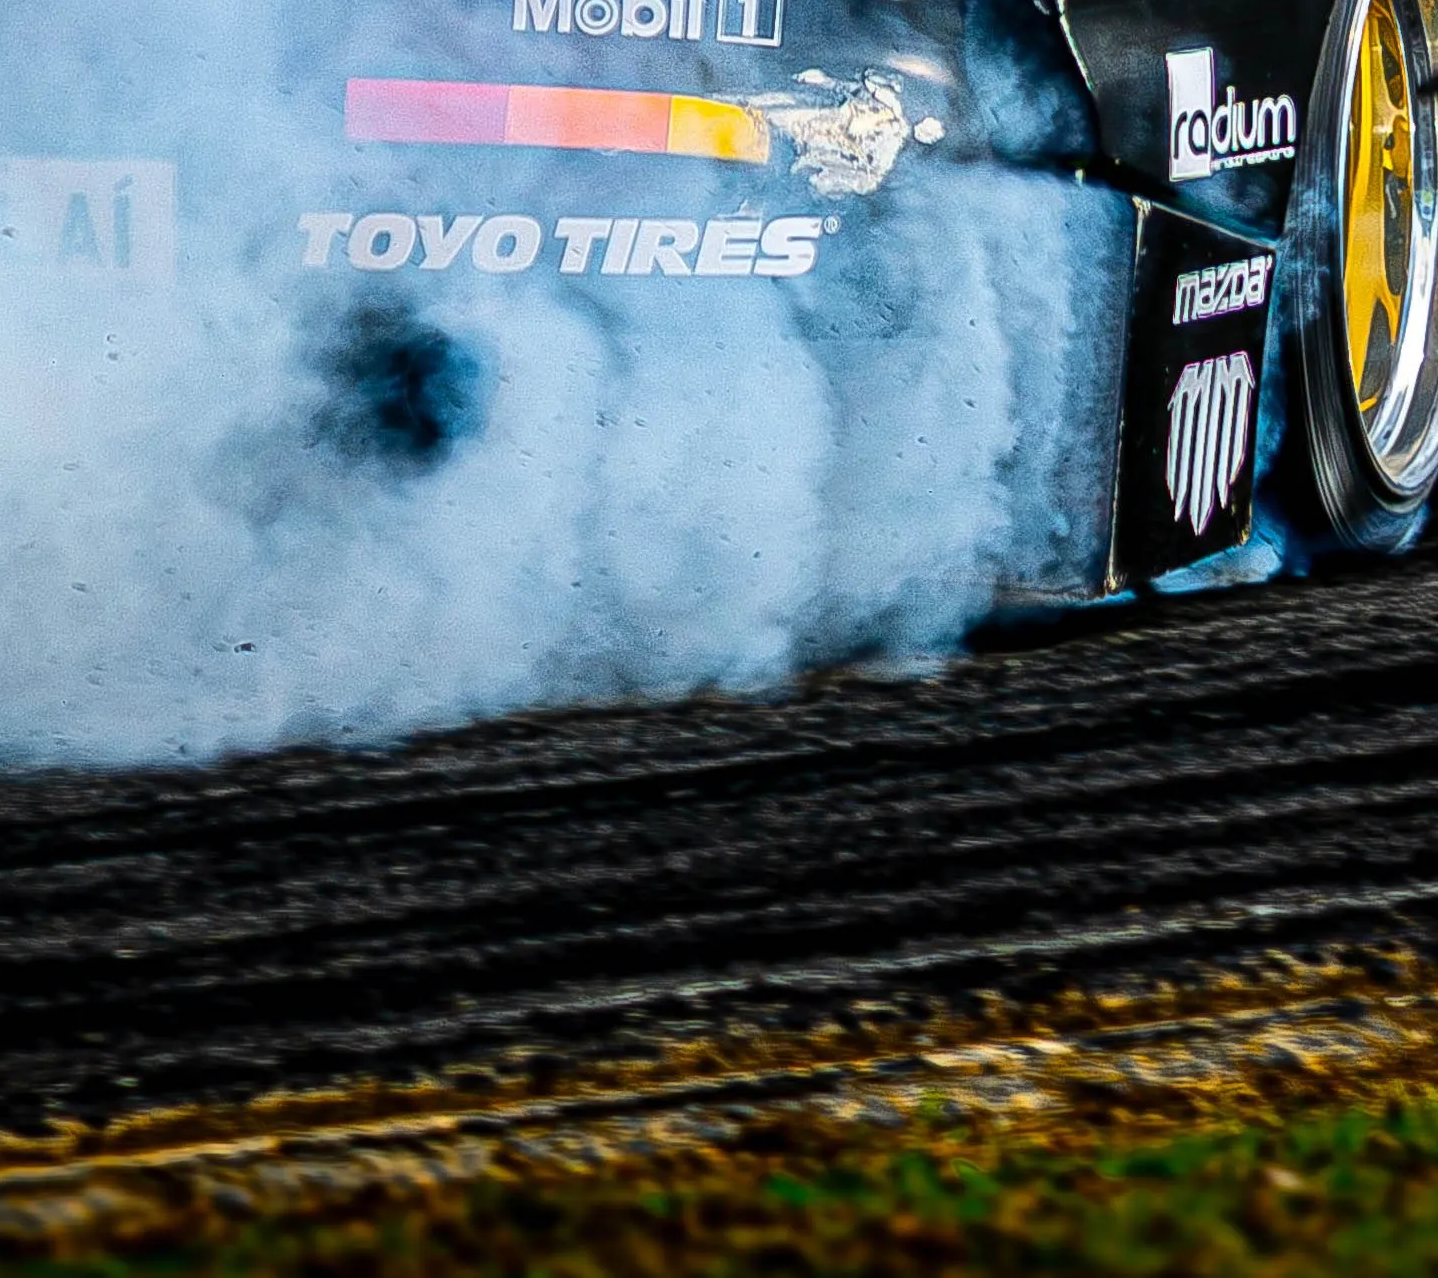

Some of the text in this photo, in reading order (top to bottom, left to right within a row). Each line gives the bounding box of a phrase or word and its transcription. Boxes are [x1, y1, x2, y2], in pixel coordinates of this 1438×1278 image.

[1173, 85, 1297, 161] radium
[298, 212, 825, 277] TOYO TIRES
[1172, 255, 1272, 326] mazda
